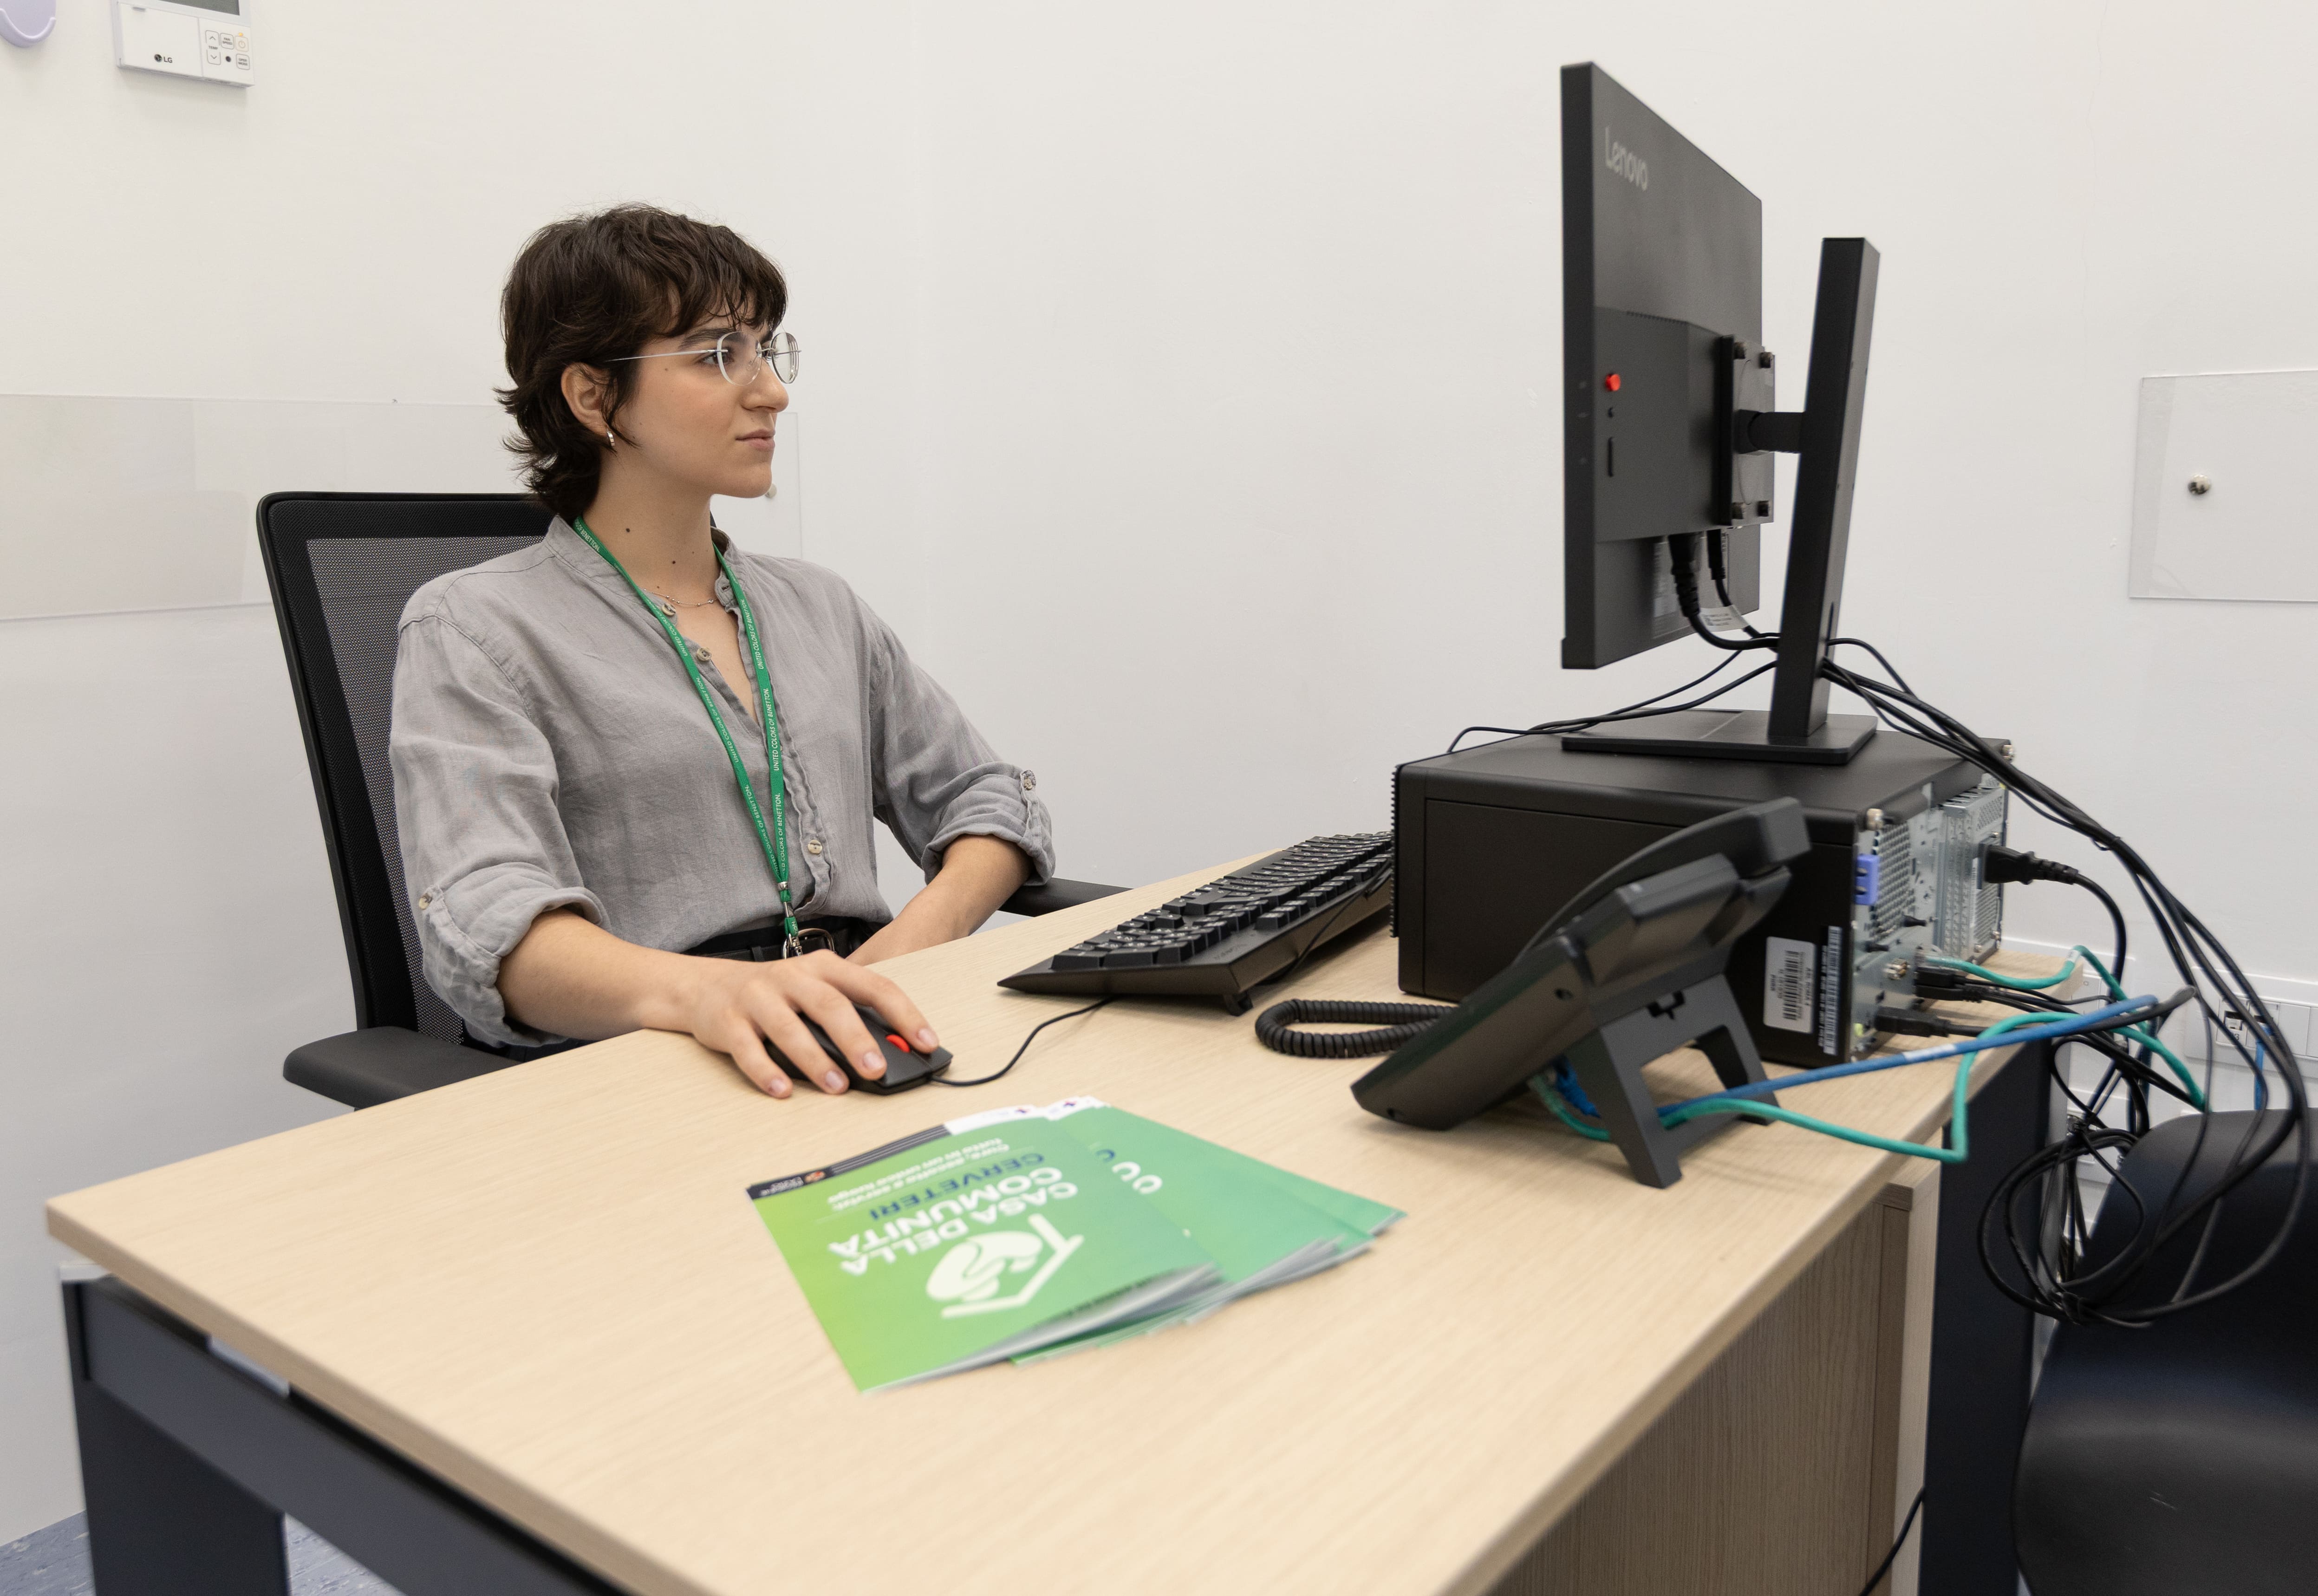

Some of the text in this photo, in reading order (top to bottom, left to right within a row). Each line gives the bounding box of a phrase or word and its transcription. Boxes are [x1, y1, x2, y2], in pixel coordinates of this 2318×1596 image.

[1605, 126, 1648, 192] Lenovo
[747, 622, 754, 631] OF
[675, 637, 688, 656] UNITED
[750, 631, 760, 651] COLORS
[755, 651, 764, 670] UNITED
[711, 708, 717, 716] OF
[716, 717, 729, 740] COLORS
[727, 741, 739, 763] UNITED
[778, 828, 783, 836] OF
[870, 1153, 1045, 1221] CERVETERI
[840, 1182, 1078, 1276] CASA DELLA
